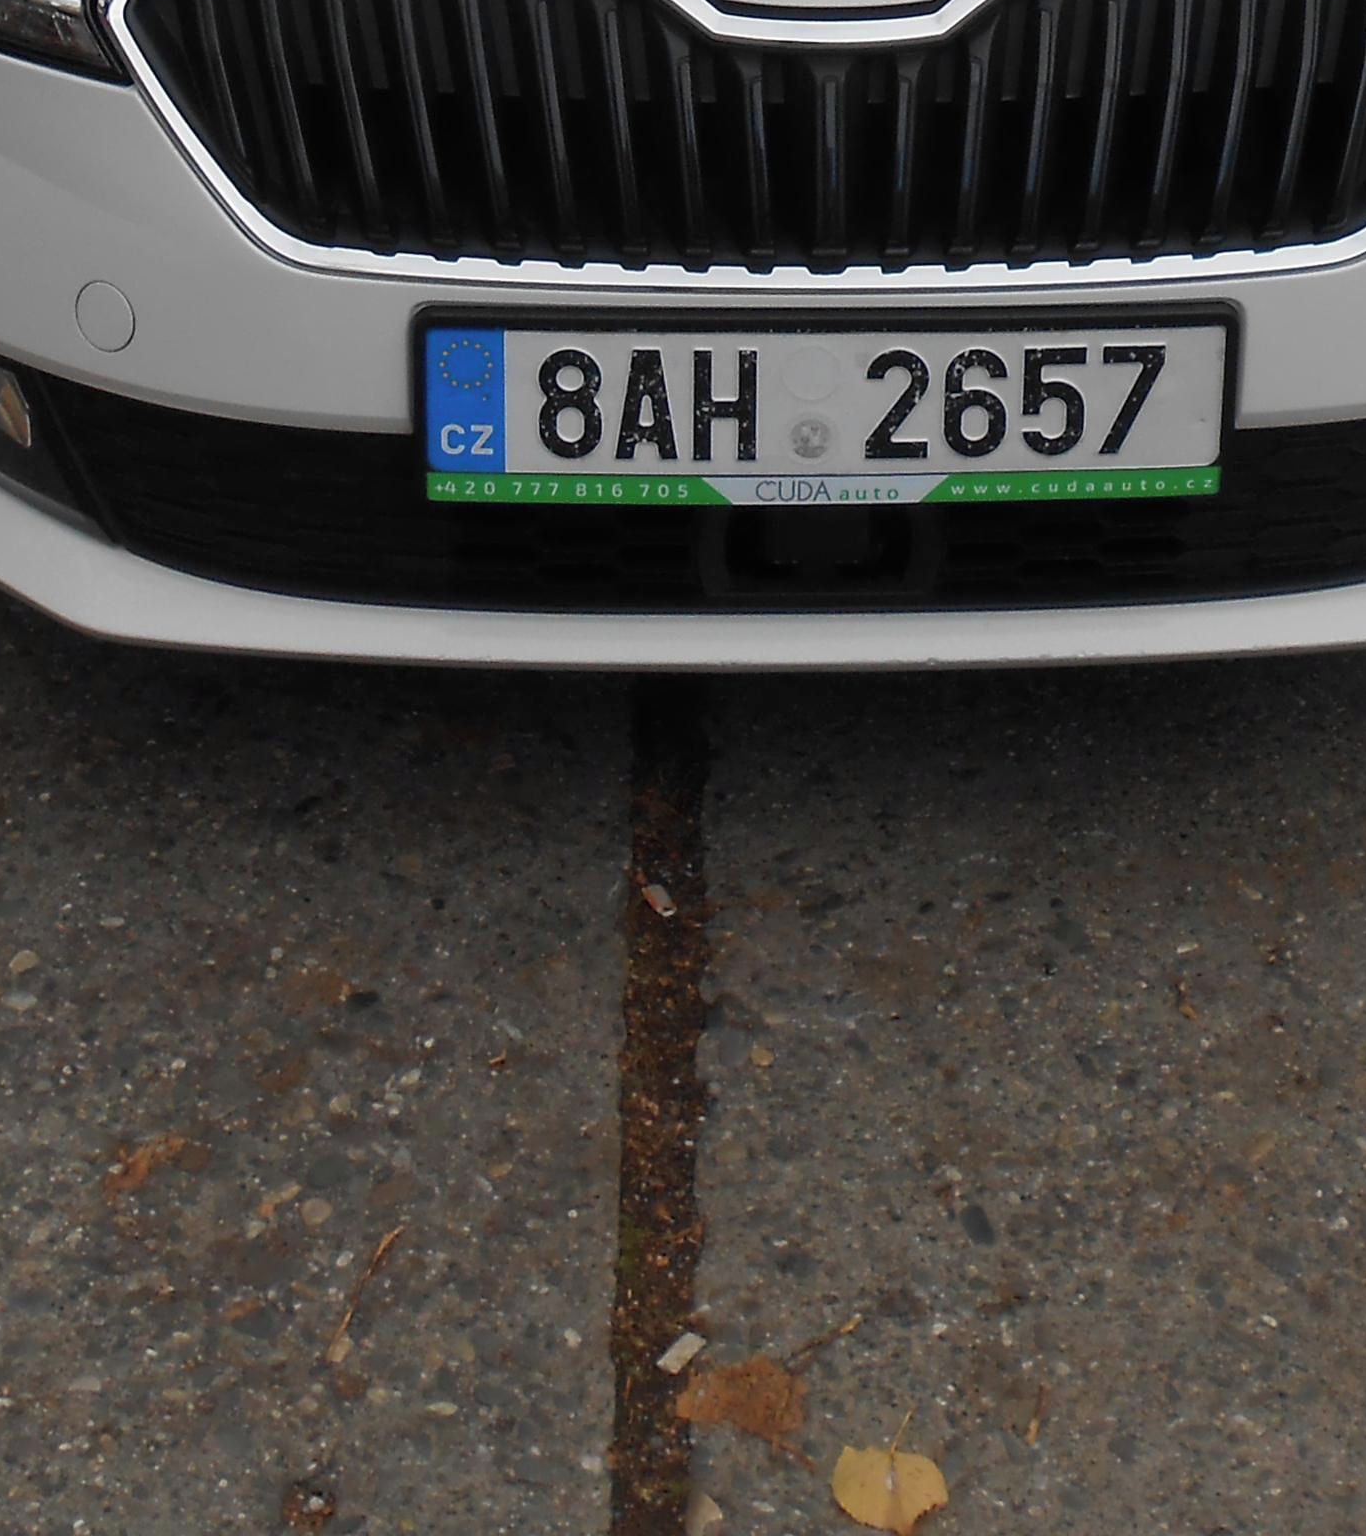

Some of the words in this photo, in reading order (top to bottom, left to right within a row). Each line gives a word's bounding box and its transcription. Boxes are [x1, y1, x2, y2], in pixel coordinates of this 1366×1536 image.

[538, 347, 759, 461] 8AH
[864, 343, 1167, 460] 2657
[440, 424, 494, 456] CZ
[435, 479, 496, 496] +420
[512, 481, 560, 496] 777
[575, 482, 624, 498] 816
[639, 482, 689, 499] 705
[838, 486, 900, 501] auto
[950, 477, 1213, 497] www.cudaauto.cz
